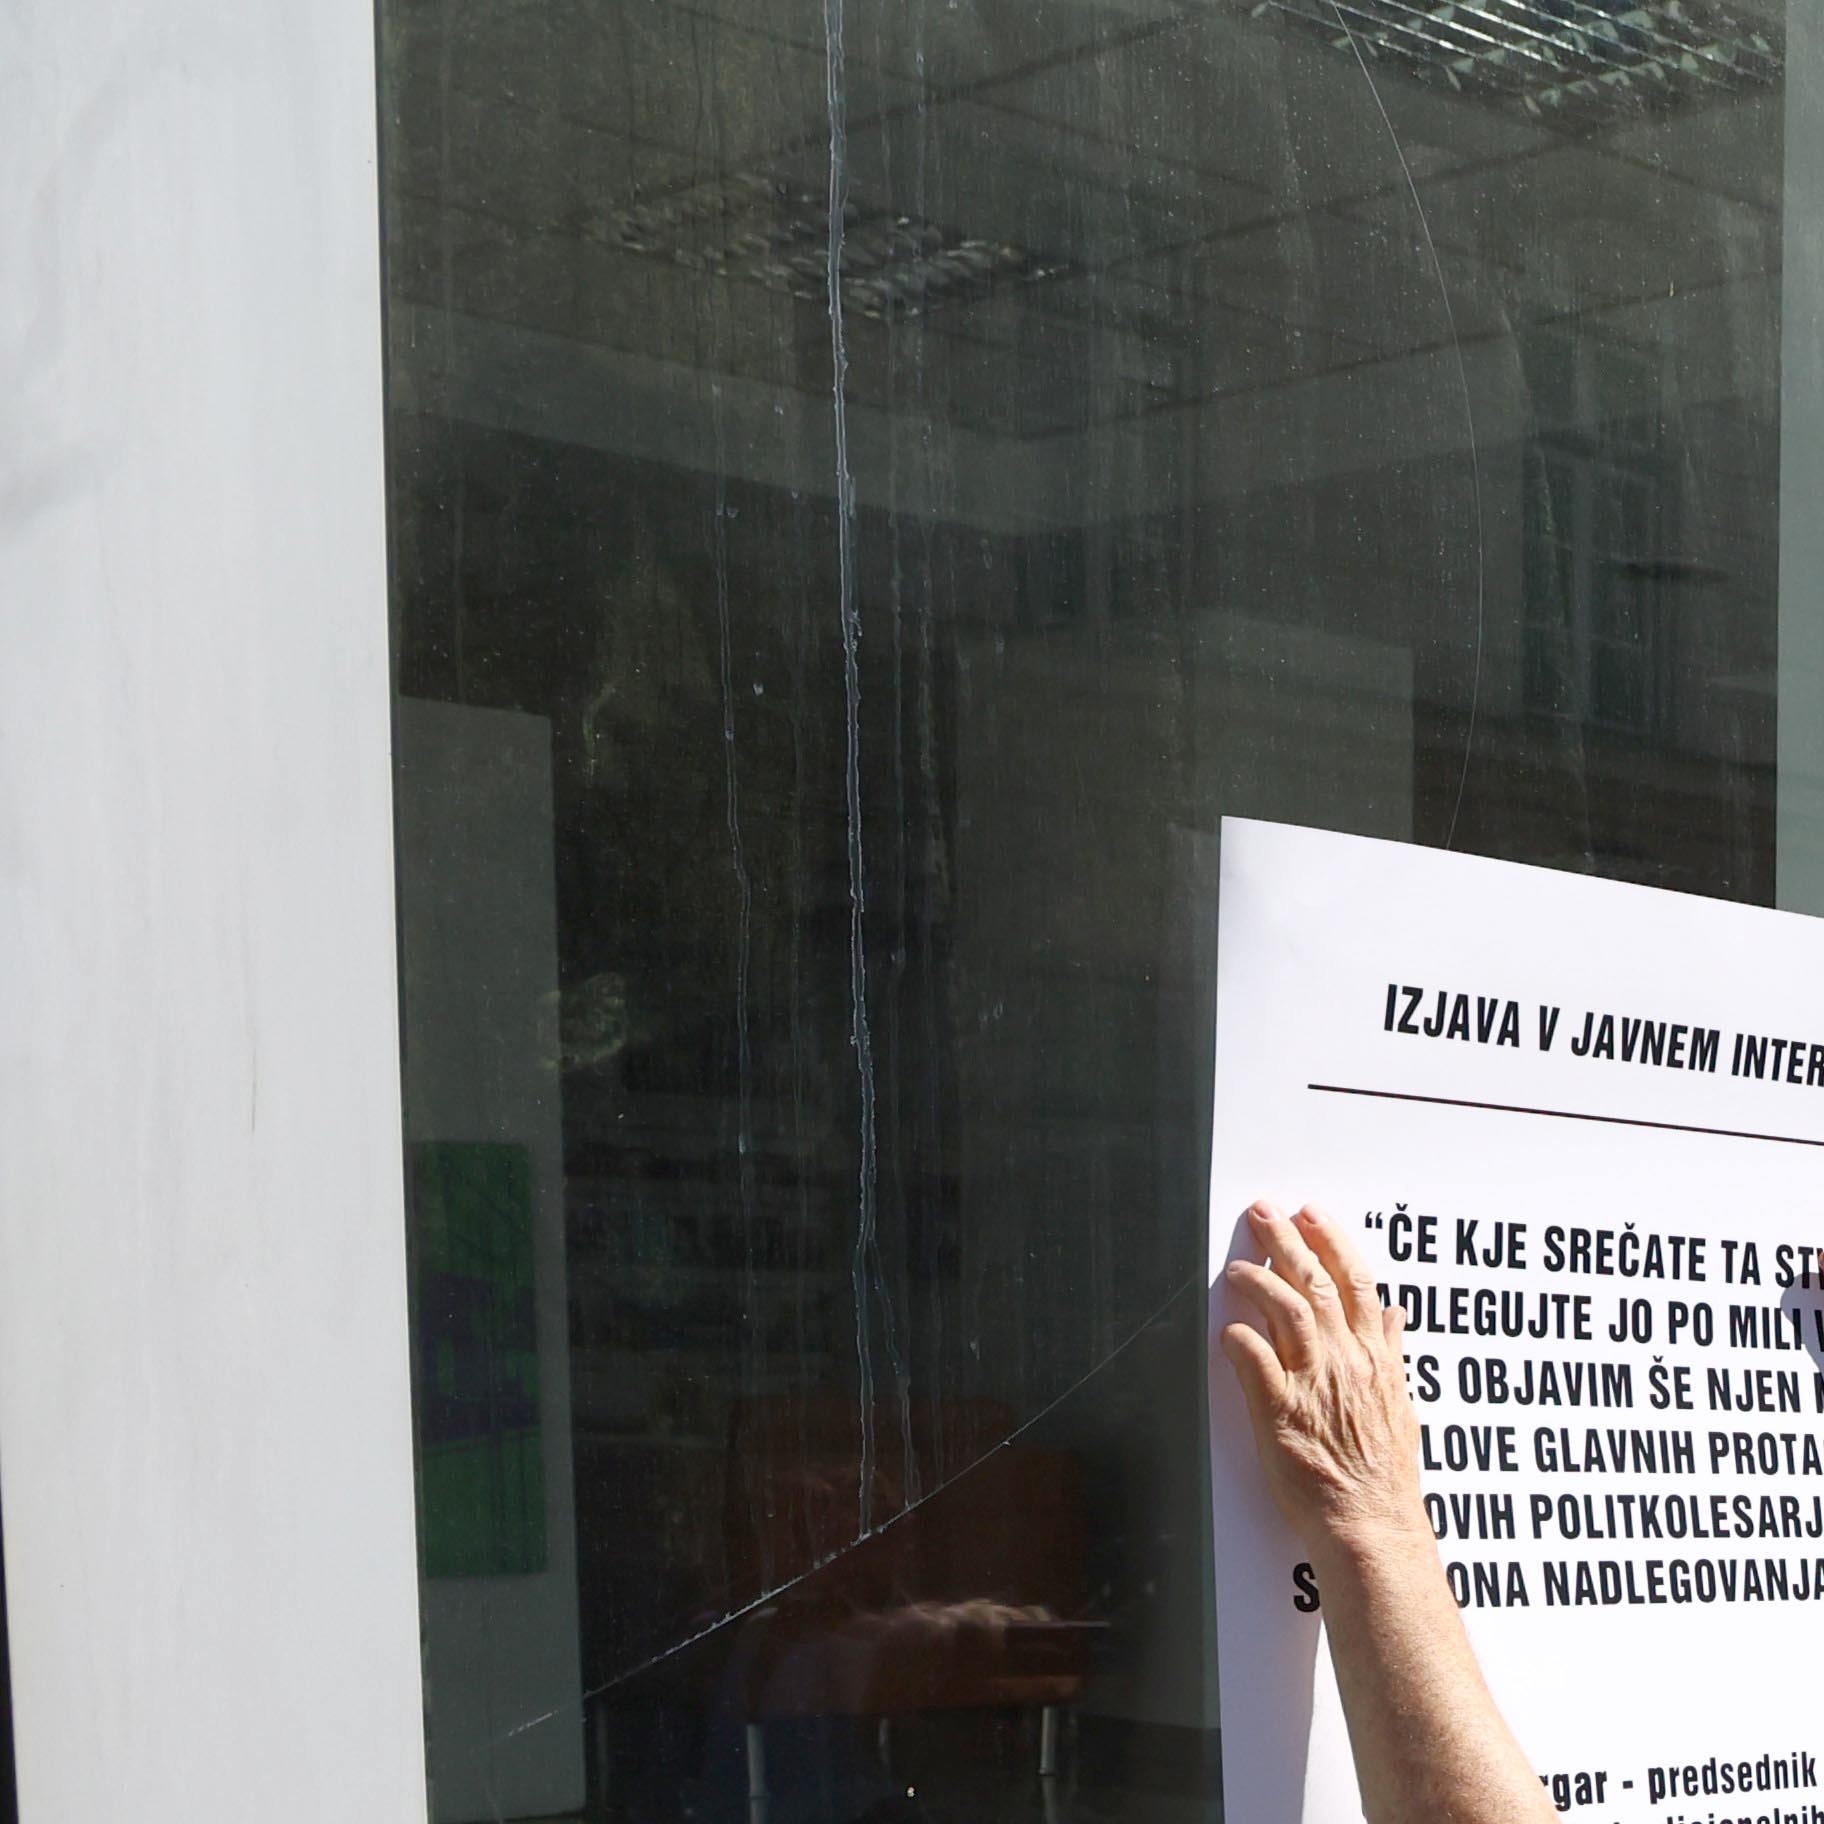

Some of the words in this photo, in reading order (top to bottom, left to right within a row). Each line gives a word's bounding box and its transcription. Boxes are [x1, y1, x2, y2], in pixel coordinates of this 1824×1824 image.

[1384, 984, 1519, 1048] IZJAVA
[1540, 1005, 1560, 1051] V
[1571, 1012, 1720, 1073] JAVNEM
[1365, 1203, 1437, 1263] “ČE
[1456, 1218, 1526, 1269] KJE
[1544, 1222, 1706, 1282] SREČATE
[1721, 1240, 1761, 1285] TA
[1376, 1283, 1592, 1343] ADLEGUJTE
[1609, 1298, 1652, 1344] JO
[1668, 1301, 1713, 1346] PO
[1729, 1302, 1805, 1353] MILI
[1458, 1357, 1633, 1408] OBJAVIM
[1649, 1356, 1694, 1410] ŠE
[1707, 1368, 1801, 1413] NJEN
[1420, 1424, 1518, 1472] LOVE
[1534, 1427, 1695, 1474] GLAVNIH
[1422, 1493, 1515, 1540] OVIH
[1648, 1752, 1817, 1804] predsednik
